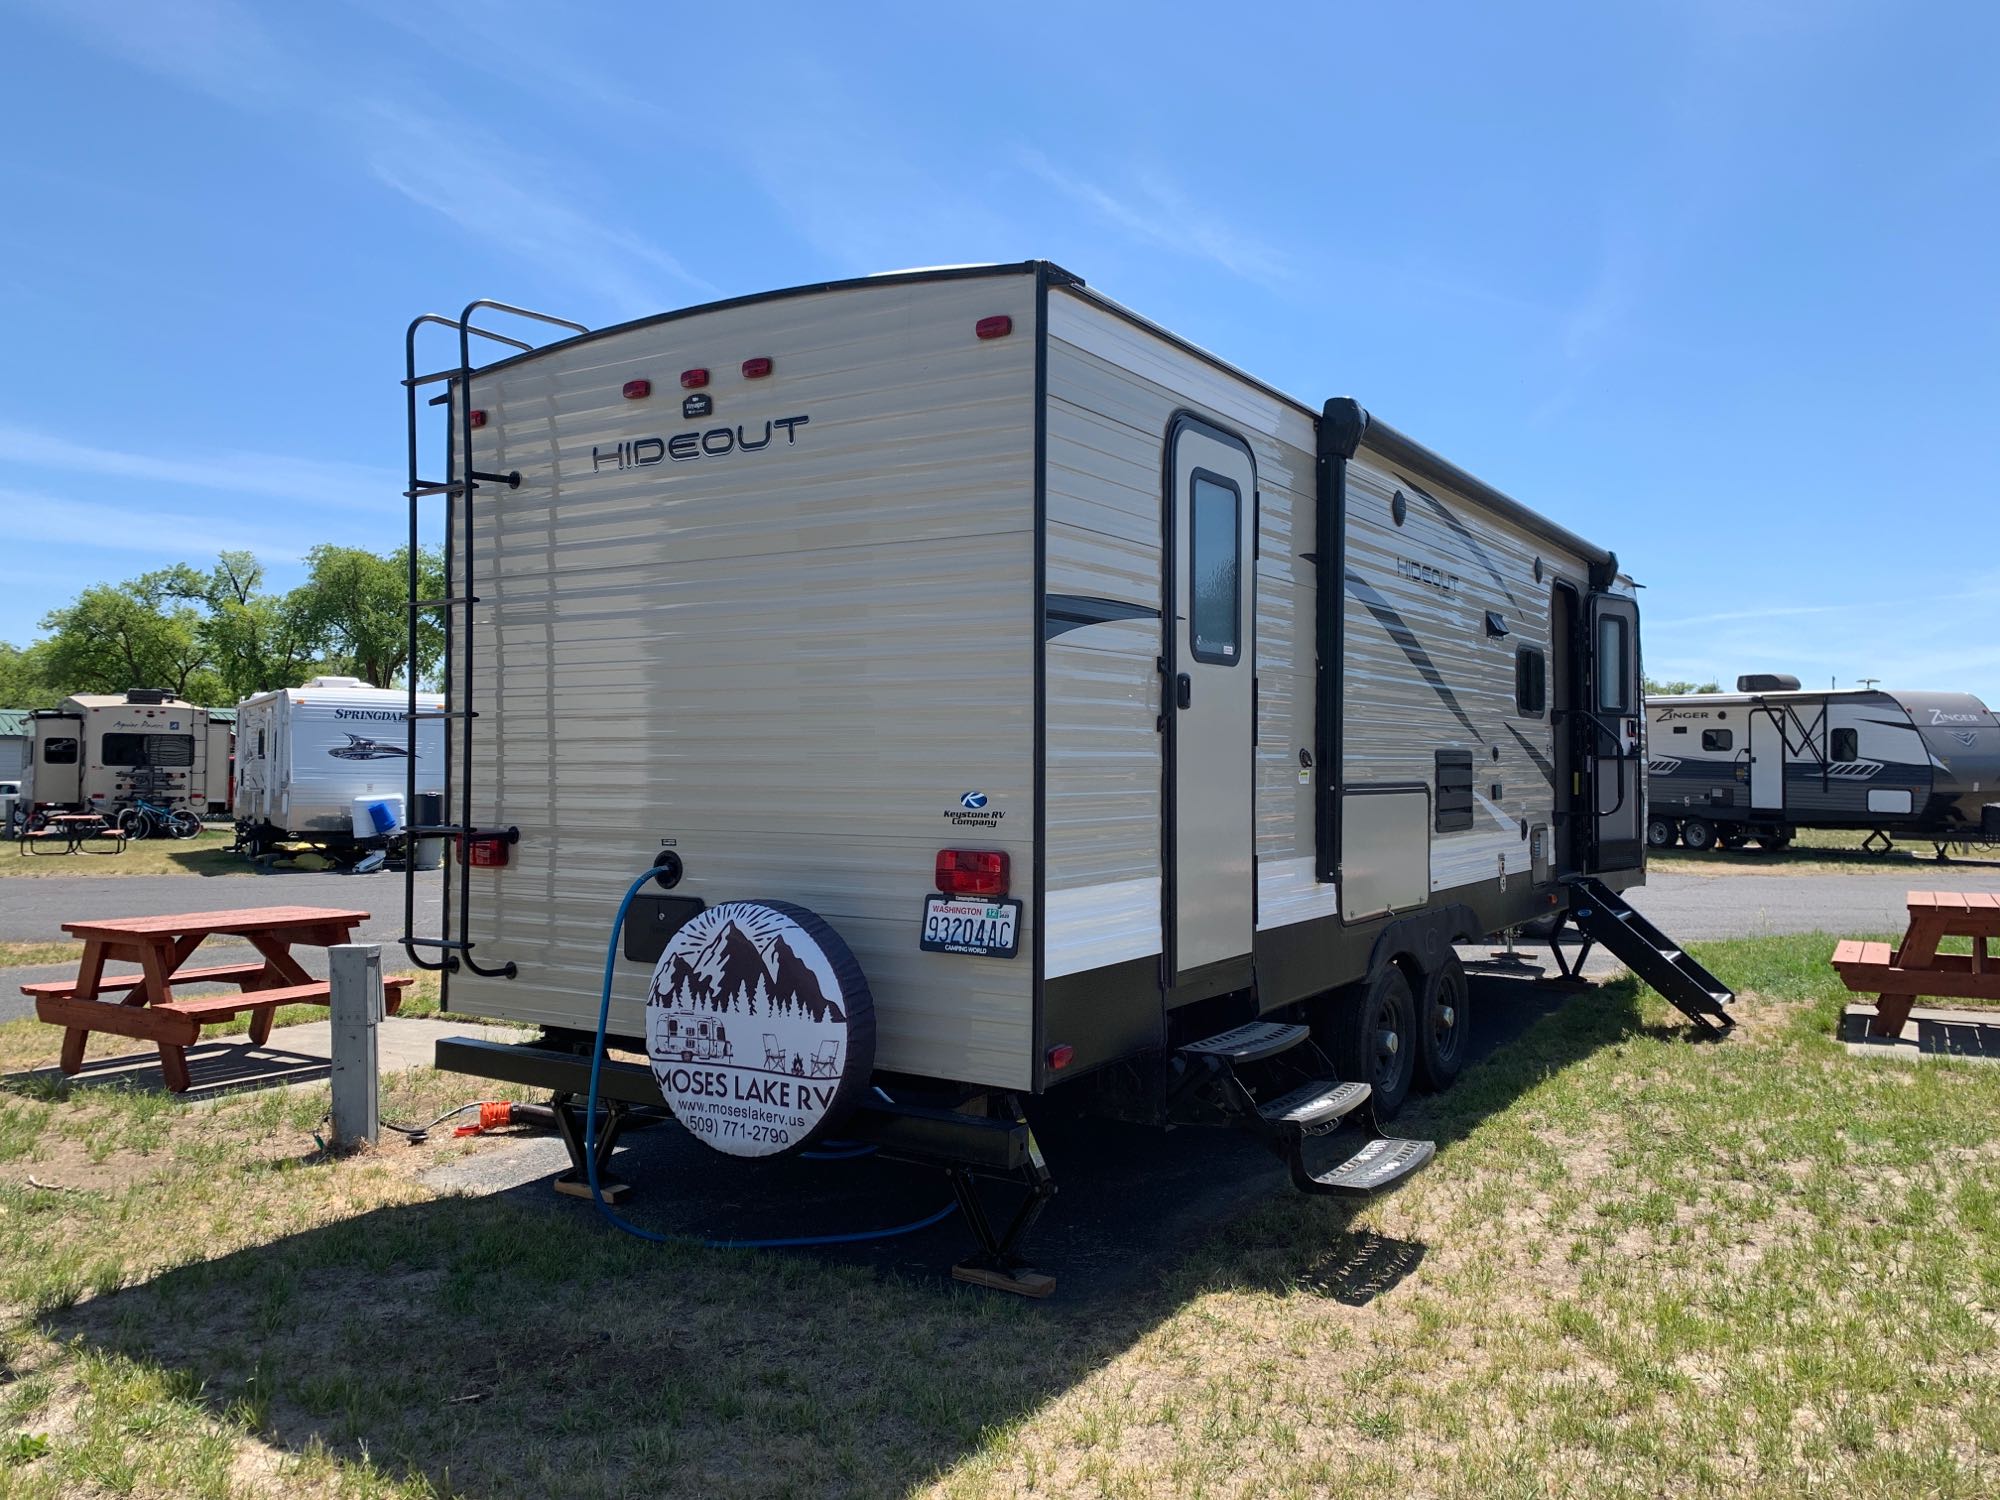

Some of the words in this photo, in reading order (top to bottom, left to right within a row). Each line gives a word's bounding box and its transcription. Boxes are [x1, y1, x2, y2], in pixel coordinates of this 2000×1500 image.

[592, 415, 809, 473] HIDEOUT
[1397, 556, 1459, 592] HIDEOUT
[334, 708, 409, 721] SPRINGDAL
[1656, 708, 1709, 722] ZINGER
[1928, 709, 1979, 725] ZINGER
[943, 810, 990, 819] Keystone
[952, 818, 997, 828] Company
[932, 905, 982, 916] WASHINGTON
[927, 916, 1011, 948] 93204AC
[944, 944, 967, 953] CAMPING
[968, 946, 987, 954] WORLD
[655, 1068, 728, 1098] MOSES
[734, 1075, 790, 1108] LAKE
[797, 1085, 835, 1111] RV
[678, 1100, 805, 1127] www.moseslakerv.us
[686, 1115, 718, 1137] (509)
[723, 1120, 789, 1144] 771-2790
